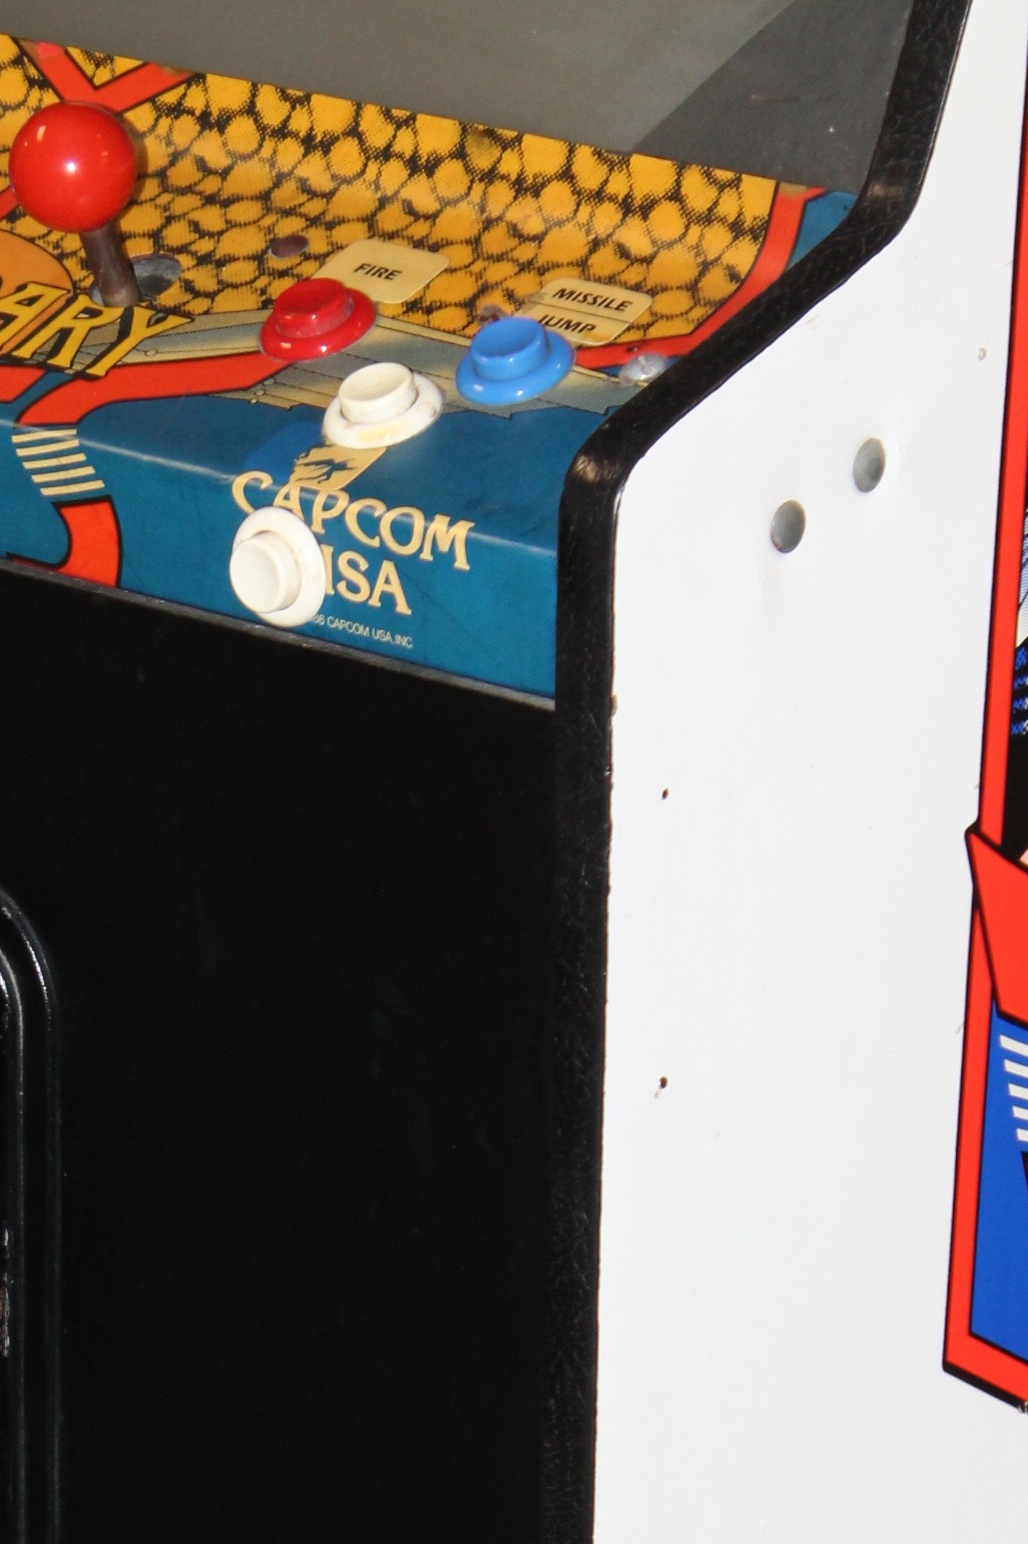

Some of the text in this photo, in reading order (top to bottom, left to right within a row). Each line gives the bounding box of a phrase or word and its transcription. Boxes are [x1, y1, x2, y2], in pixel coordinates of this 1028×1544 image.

[353, 262, 403, 281] FIRE
[552, 287, 634, 312] MISSILE
[231, 470, 475, 571] CAPCOM
[326, 615, 370, 637] CAPCOM
